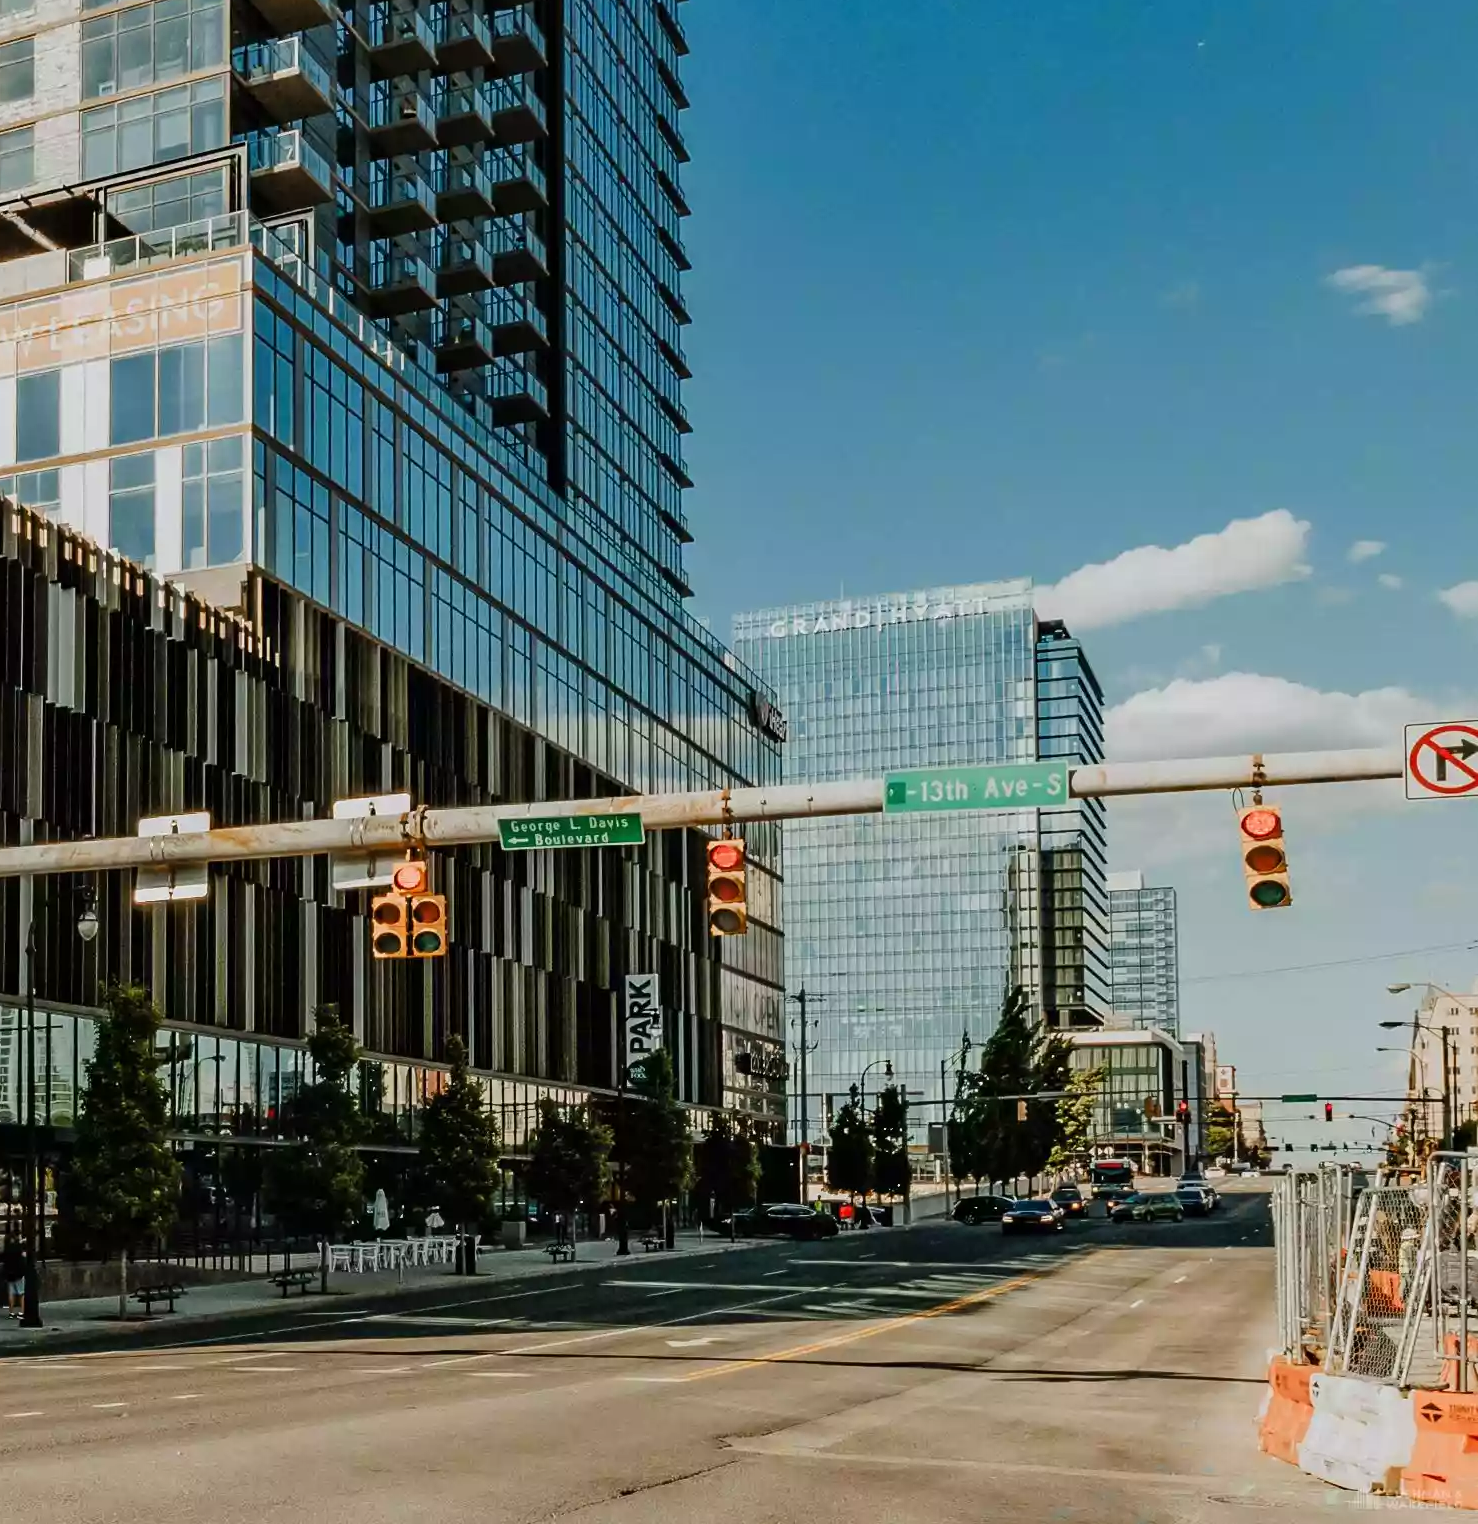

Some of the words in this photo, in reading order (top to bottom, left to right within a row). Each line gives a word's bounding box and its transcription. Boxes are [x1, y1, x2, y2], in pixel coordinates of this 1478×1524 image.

[48, 282, 225, 352] LEASING
[770, 610, 871, 638] GRAND
[891, 596, 988, 625] HYATT
[510, 820, 561, 834] George
[569, 817, 582, 830] L.
[588, 816, 629, 830] Davis
[534, 832, 610, 846] Boulevard
[628, 979, 652, 1054] PARK
